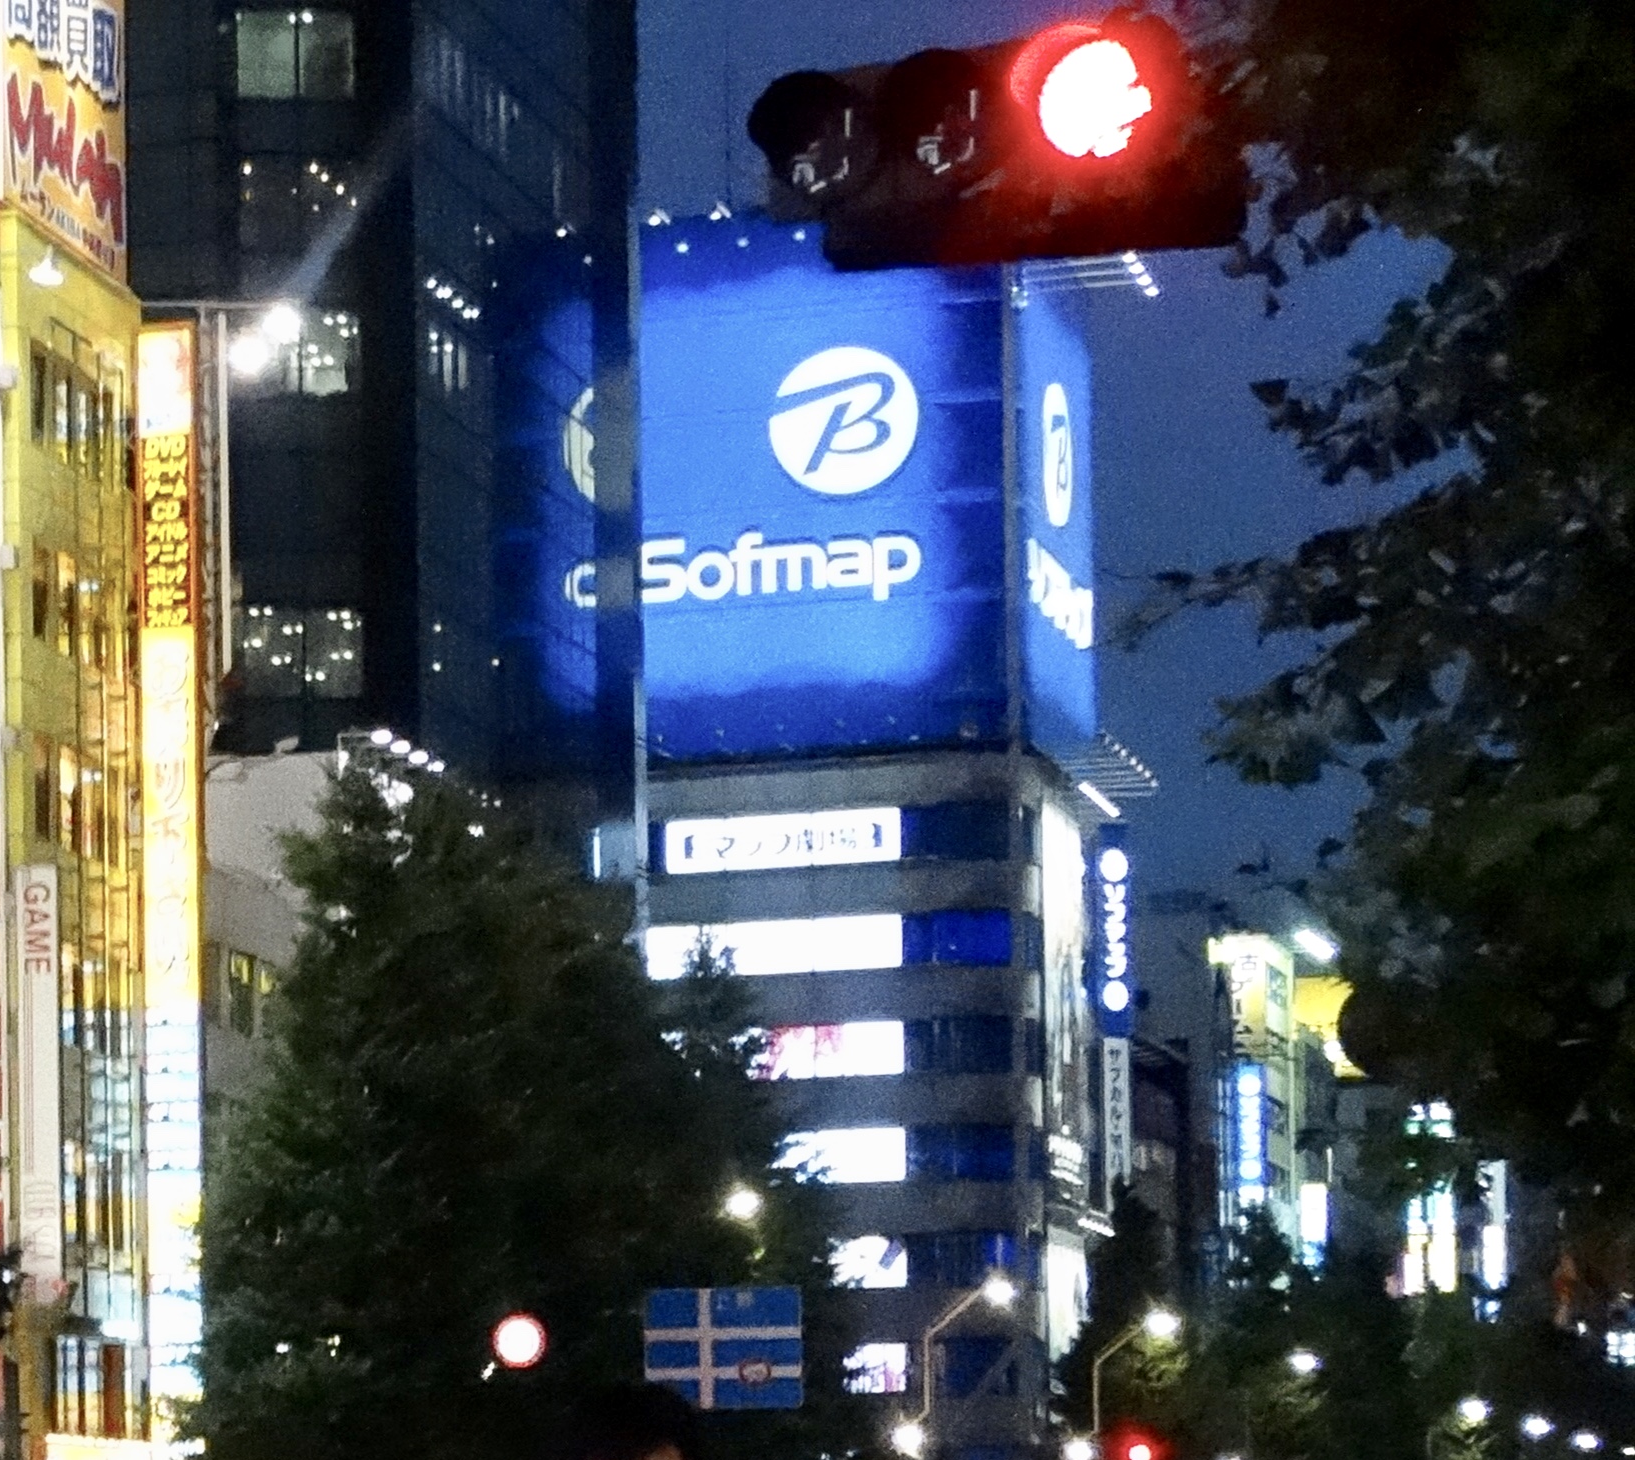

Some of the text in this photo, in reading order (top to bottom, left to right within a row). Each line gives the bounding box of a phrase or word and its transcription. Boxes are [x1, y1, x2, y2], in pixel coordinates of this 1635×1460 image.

[145, 436, 186, 459] DVD
[151, 500, 181, 521] CD
[145, 542, 189, 565] アニメ
[641, 530, 922, 605] Sofmap
[23, 883, 51, 977] GAME
